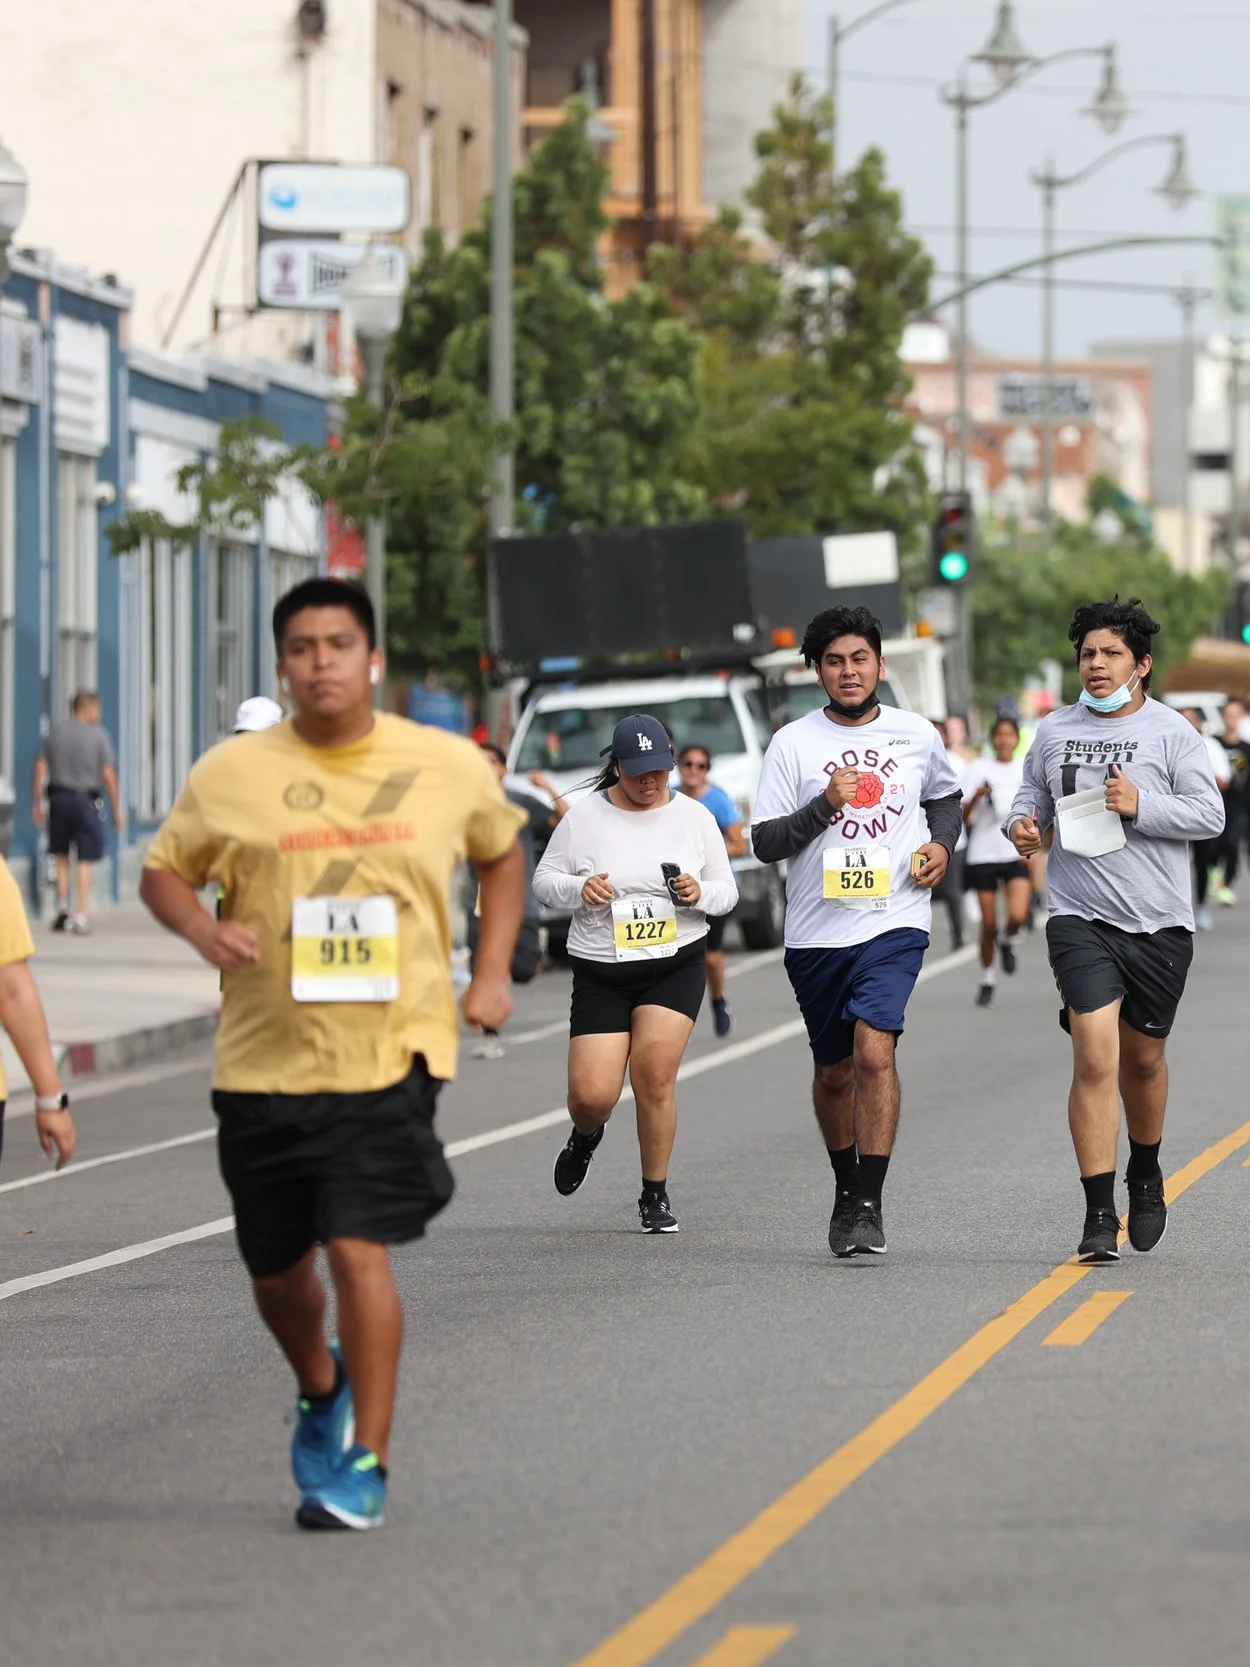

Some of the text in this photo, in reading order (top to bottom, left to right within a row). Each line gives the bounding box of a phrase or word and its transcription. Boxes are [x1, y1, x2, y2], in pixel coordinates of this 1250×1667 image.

[636, 732, 653, 751] LA
[1064, 740, 1139, 753] Students
[844, 854, 868, 868] LA
[840, 870, 874, 889] 526
[625, 920, 667, 941] 1227
[320, 939, 371, 965] 915
